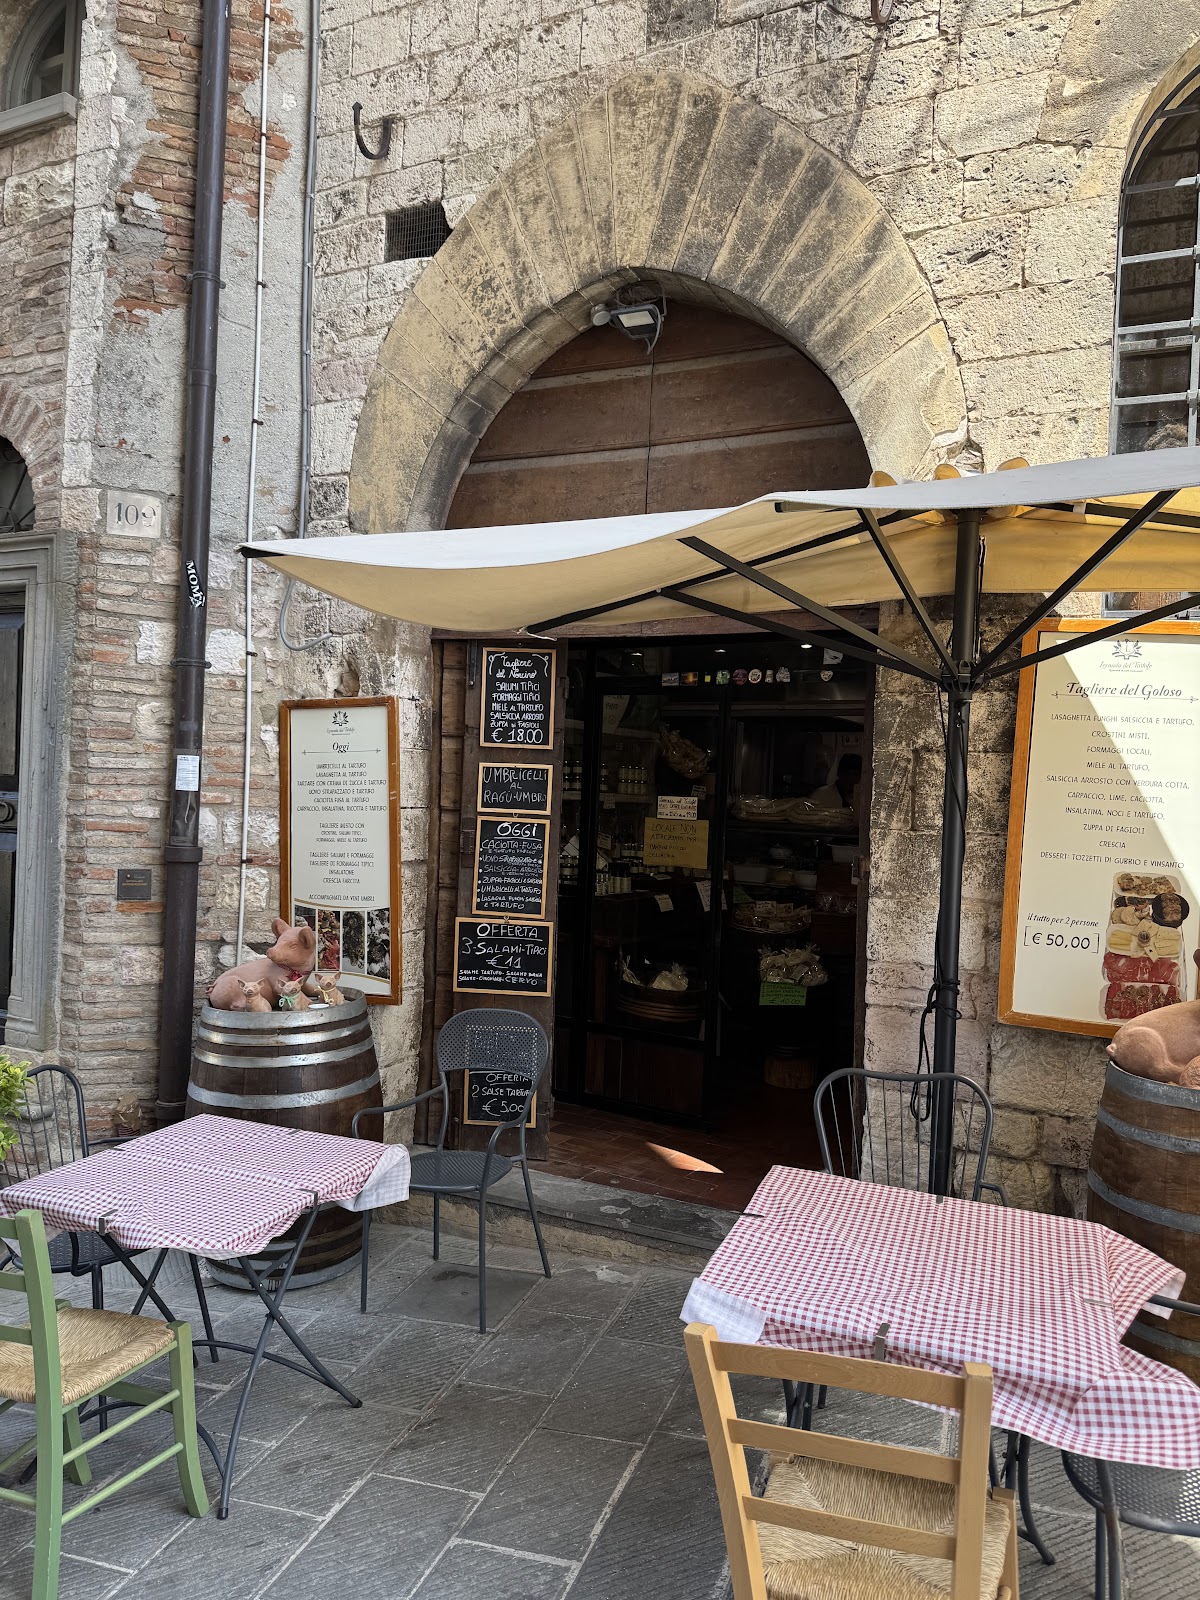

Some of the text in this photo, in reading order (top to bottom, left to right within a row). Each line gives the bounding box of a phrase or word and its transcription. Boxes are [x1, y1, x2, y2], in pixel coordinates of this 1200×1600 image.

[115, 503, 156, 527] 109
[501, 656, 533, 670] Tagliere
[496, 682, 518, 691] SALUMI
[1066, 682, 1182, 700] Tagliere del Goloso
[517, 703, 544, 711] TARTUFO
[491, 728, 503, 742] €
[332, 742, 349, 753] Oggi
[1087, 746, 1123, 754] FORMAGGI
[497, 822, 537, 837] OGGI
[1116, 826, 1145, 834] FAGIOLI
[1072, 854, 1102, 862] TOZZETTI
[1150, 860, 1184, 868] VINSANTO
[477, 923, 538, 938] OFFERTA
[1032, 933, 1090, 949] € 50,00
[486, 954, 521, 968] € 11
[472, 1085, 479, 1097] 2
[482, 1087, 504, 1095] SALSE
[482, 1098, 500, 1116] €
